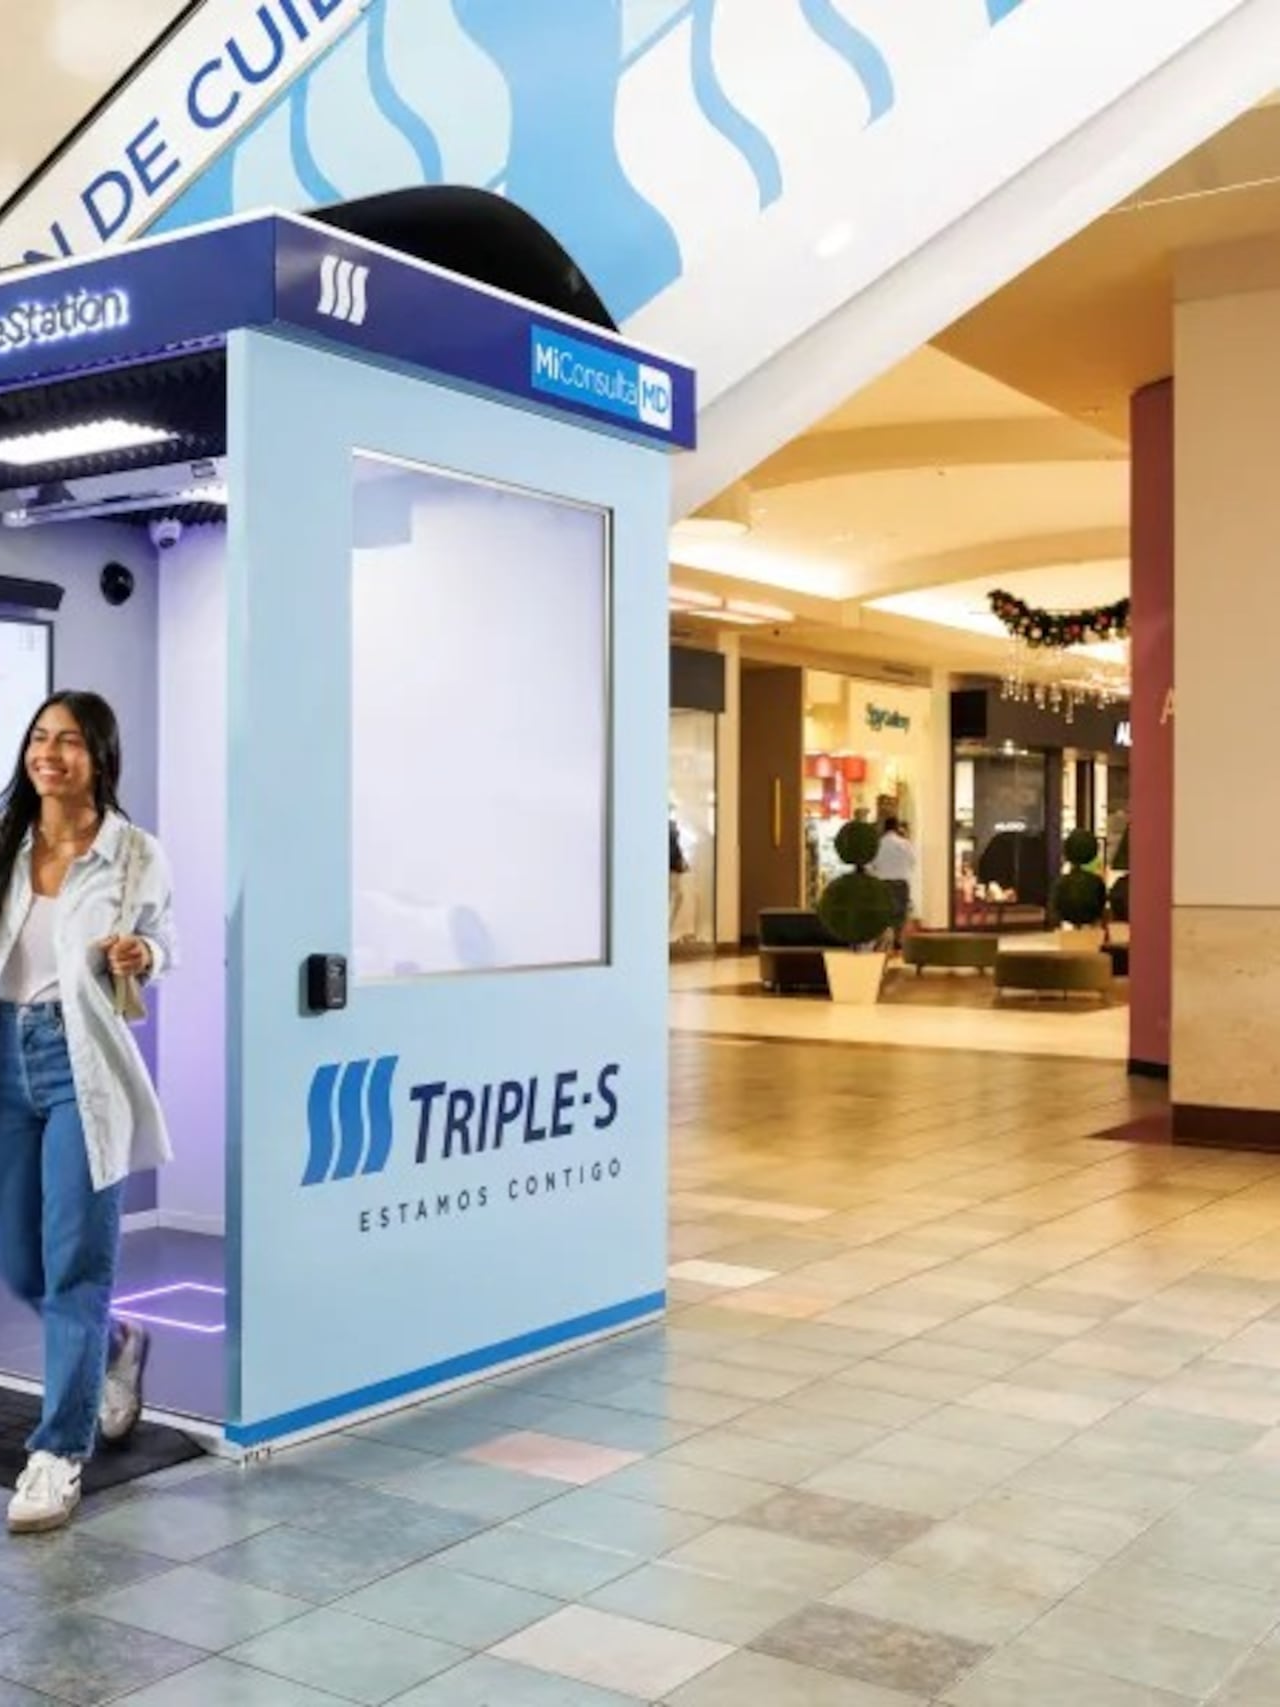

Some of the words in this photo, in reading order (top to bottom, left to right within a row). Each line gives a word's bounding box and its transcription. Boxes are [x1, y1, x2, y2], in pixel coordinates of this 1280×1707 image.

[80, 119, 180, 240] DE
[359, 1186, 488, 1232] ESTAMOS
[508, 1158, 621, 1200] CONTIGO
